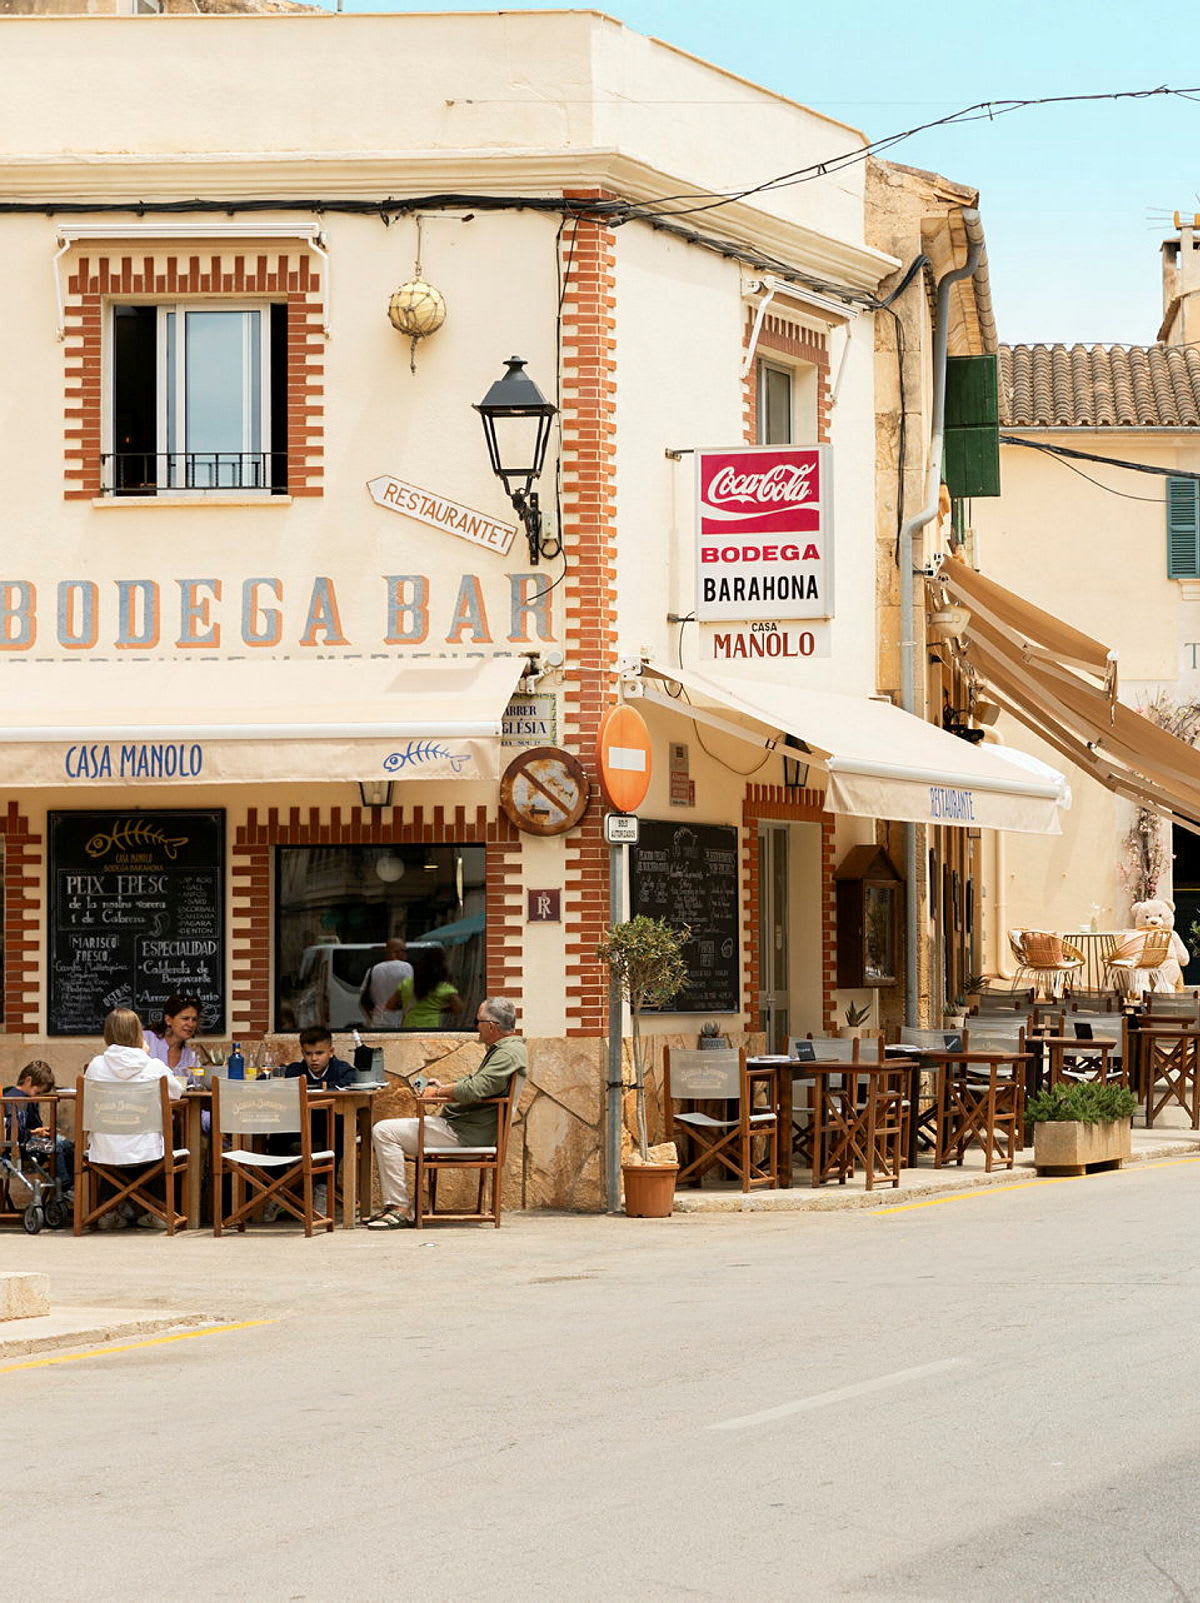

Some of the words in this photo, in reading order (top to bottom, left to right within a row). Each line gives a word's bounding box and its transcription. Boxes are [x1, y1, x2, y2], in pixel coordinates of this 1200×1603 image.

[383, 482, 513, 549] RESTAURANTET
[701, 544, 821, 563] BODEGA
[704, 575, 819, 602] BARAHONA
[0, 577, 351, 651] BODEGA
[381, 573, 559, 645] BAR
[751, 622, 778, 632] CASA
[714, 632, 815, 658] MANOLO
[504, 705, 537, 716] ARRER
[502, 718, 547, 734] GLÉSIA
[65, 744, 112, 779] CASA
[120, 744, 203, 777] MANOLO
[929, 787, 975, 821] RESTAURANTE
[66, 875, 105, 894] PEIX
[87, 895, 98, 909] la
[72, 937, 117, 949] MARISCO
[142, 941, 217, 956] ESPECIALIDAD
[76, 950, 109, 962] FRESCO
[197, 960, 209, 974] de
